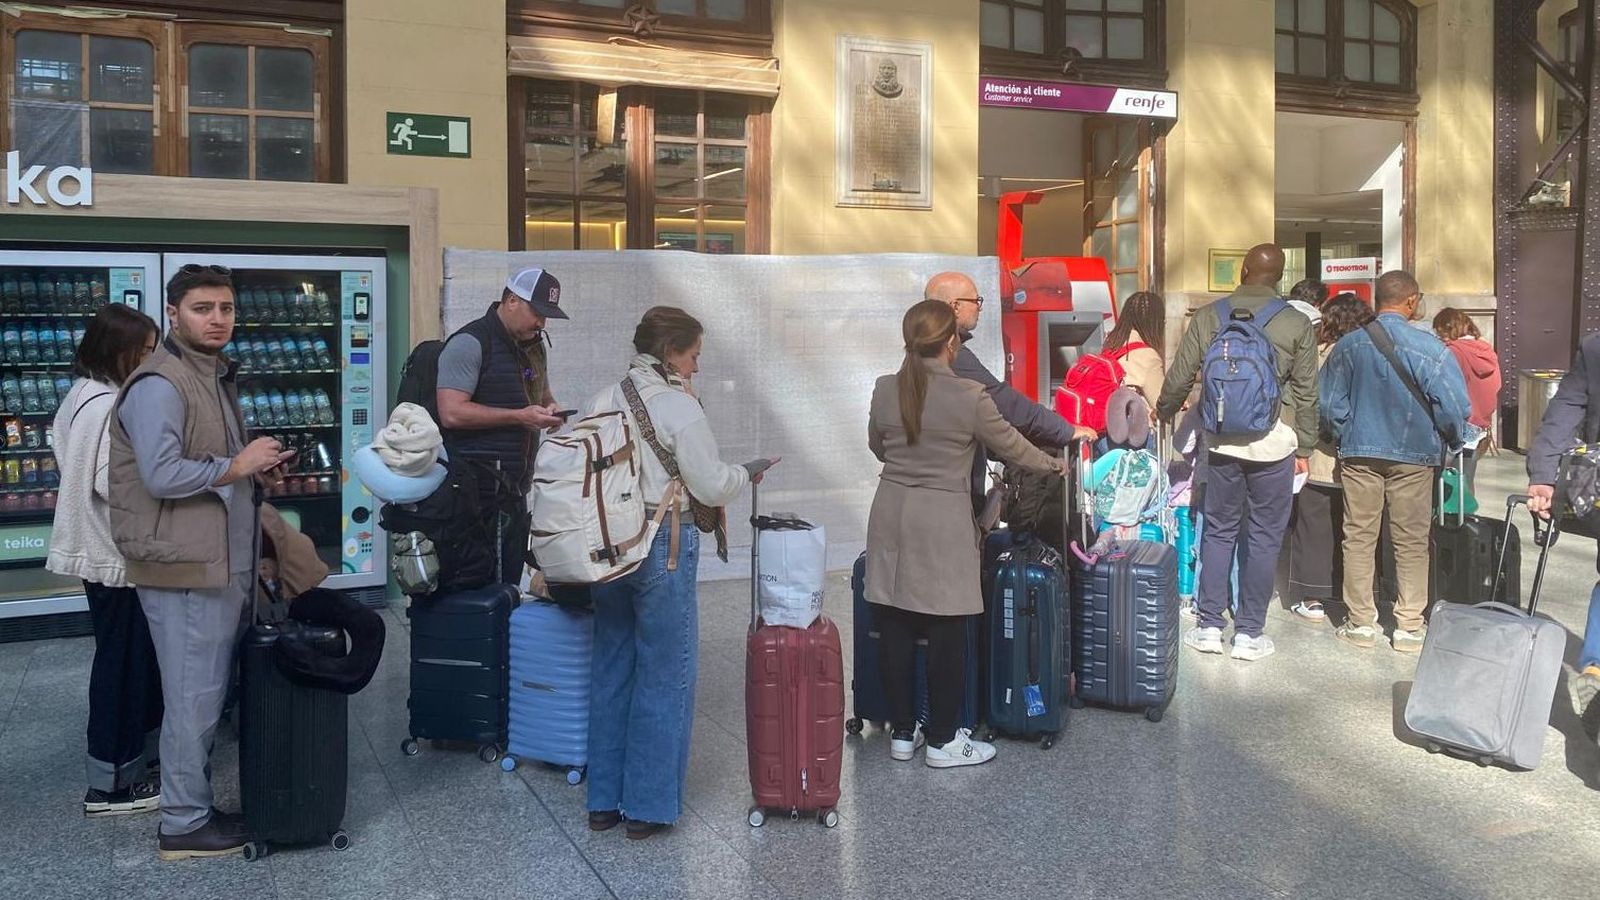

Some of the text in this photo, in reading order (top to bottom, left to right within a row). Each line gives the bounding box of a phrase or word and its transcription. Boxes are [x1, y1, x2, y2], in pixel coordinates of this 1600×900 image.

[985, 82, 1062, 97] Atención al cliente
[984, 93, 1033, 104] Customer service
[1125, 94, 1165, 113] renfe
[7, 150, 92, 206] ka
[5, 536, 44, 549] teika
